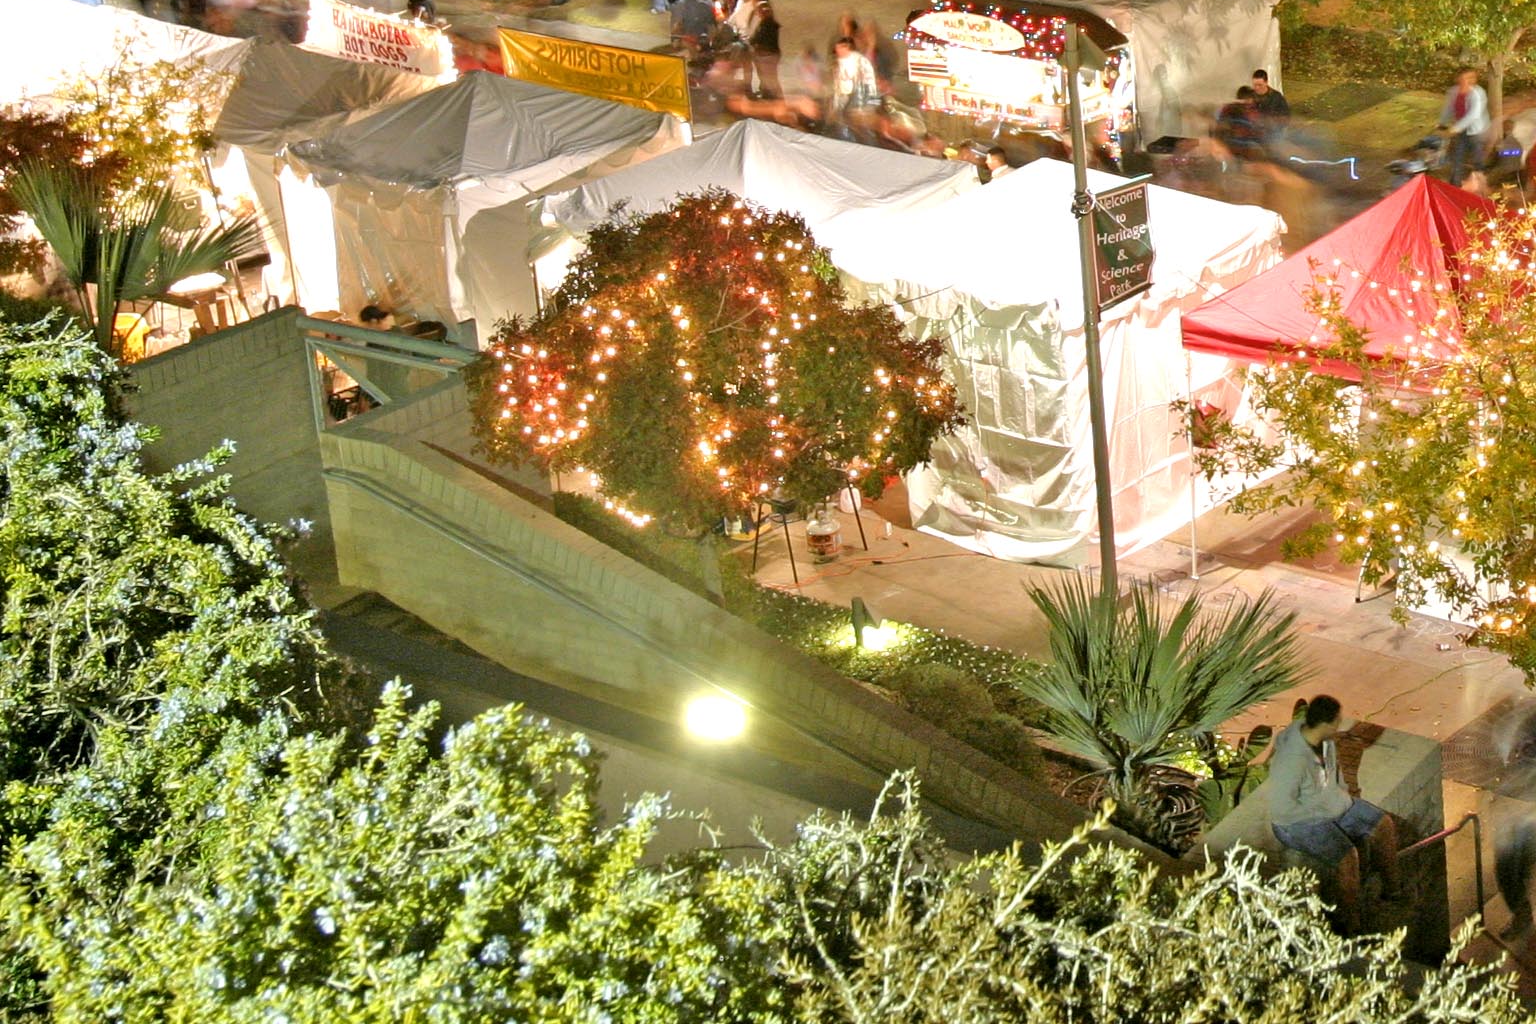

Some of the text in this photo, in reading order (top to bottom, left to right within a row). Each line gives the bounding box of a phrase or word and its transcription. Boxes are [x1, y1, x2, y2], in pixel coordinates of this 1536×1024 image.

[343, 33, 367, 55] HOT
[369, 42, 408, 63] DOGS
[1115, 212, 1127, 224] to
[1096, 223, 1147, 246] Heritage
[1117, 249, 1129, 261] &
[1101, 262, 1145, 284] Science
[1110, 279, 1132, 298] Park
